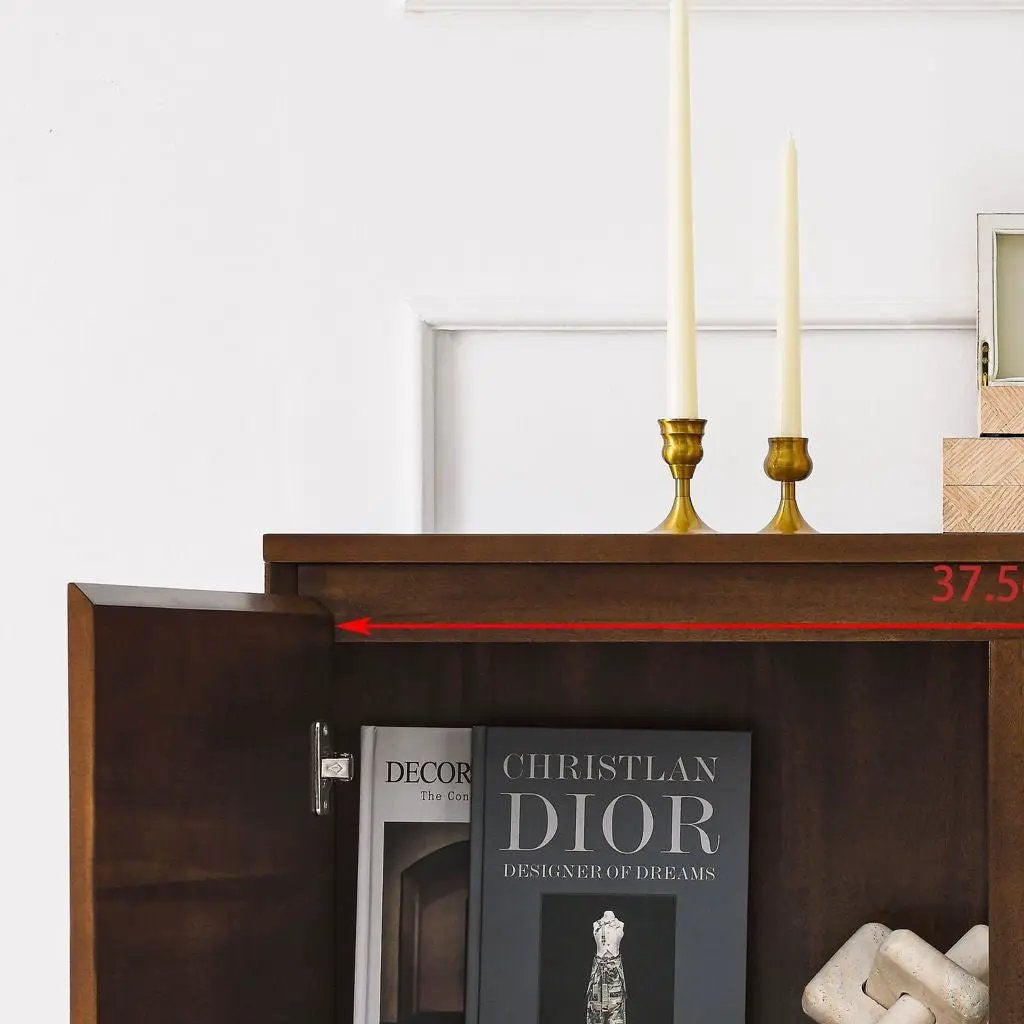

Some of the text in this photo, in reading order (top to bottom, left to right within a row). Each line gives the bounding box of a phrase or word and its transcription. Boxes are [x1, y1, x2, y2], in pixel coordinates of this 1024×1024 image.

[385, 761, 472, 784] DECOR
[502, 753, 719, 783] CHRISTLAN
[421, 791, 442, 801] The
[499, 792, 721, 855] DIOR
[503, 863, 716, 881] DESIGNER OF DREAMS
